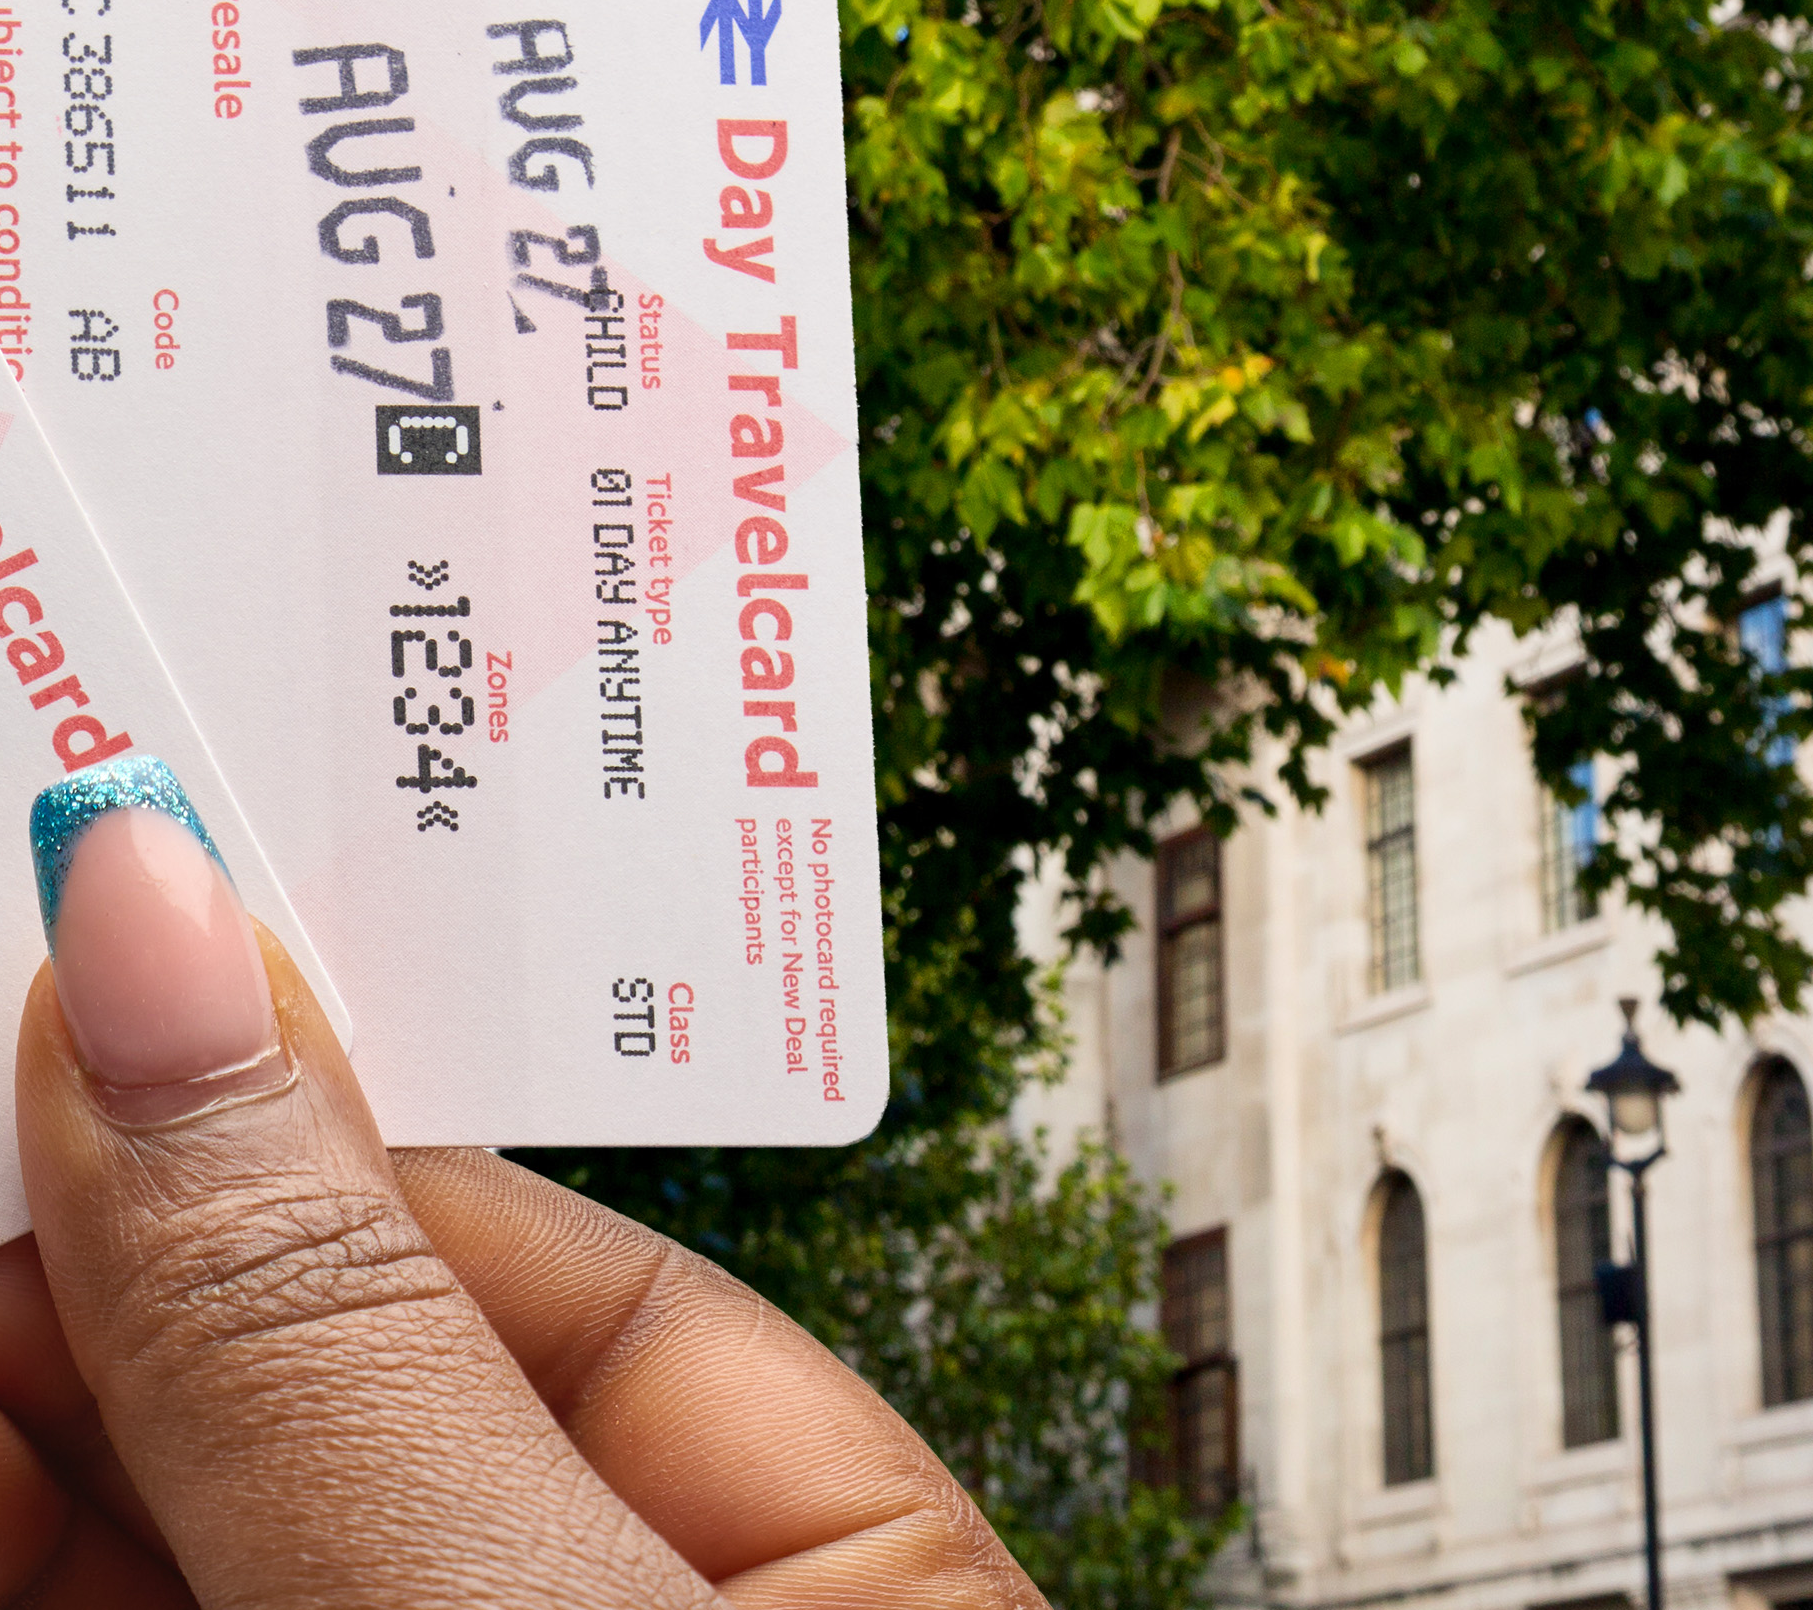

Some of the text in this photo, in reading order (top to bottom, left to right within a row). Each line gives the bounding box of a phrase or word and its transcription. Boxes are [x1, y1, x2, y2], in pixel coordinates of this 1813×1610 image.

[294, 45, 436, 265] AUG
[488, 20, 594, 189] AUG
[509, 223, 610, 312] 27
[69, 310, 122, 382] AB
[153, 289, 182, 371] Code
[327, 294, 454, 403] 27
[582, 289, 626, 413] CHILD
[639, 294, 665, 391] Status
[385, 414, 470, 466] C
[703, 119, 820, 789] Day Travelcard
[645, 473, 675, 646] Ticket type
[591, 469, 646, 800] 01 DAY ANYTIME
[487, 652, 514, 744] Zones
[735, 819, 767, 967] participants
[774, 819, 809, 1076] except for New Deal
[613, 979, 657, 1058] STD
[808, 819, 847, 1103] No photocard required
[668, 982, 696, 1066] Class
